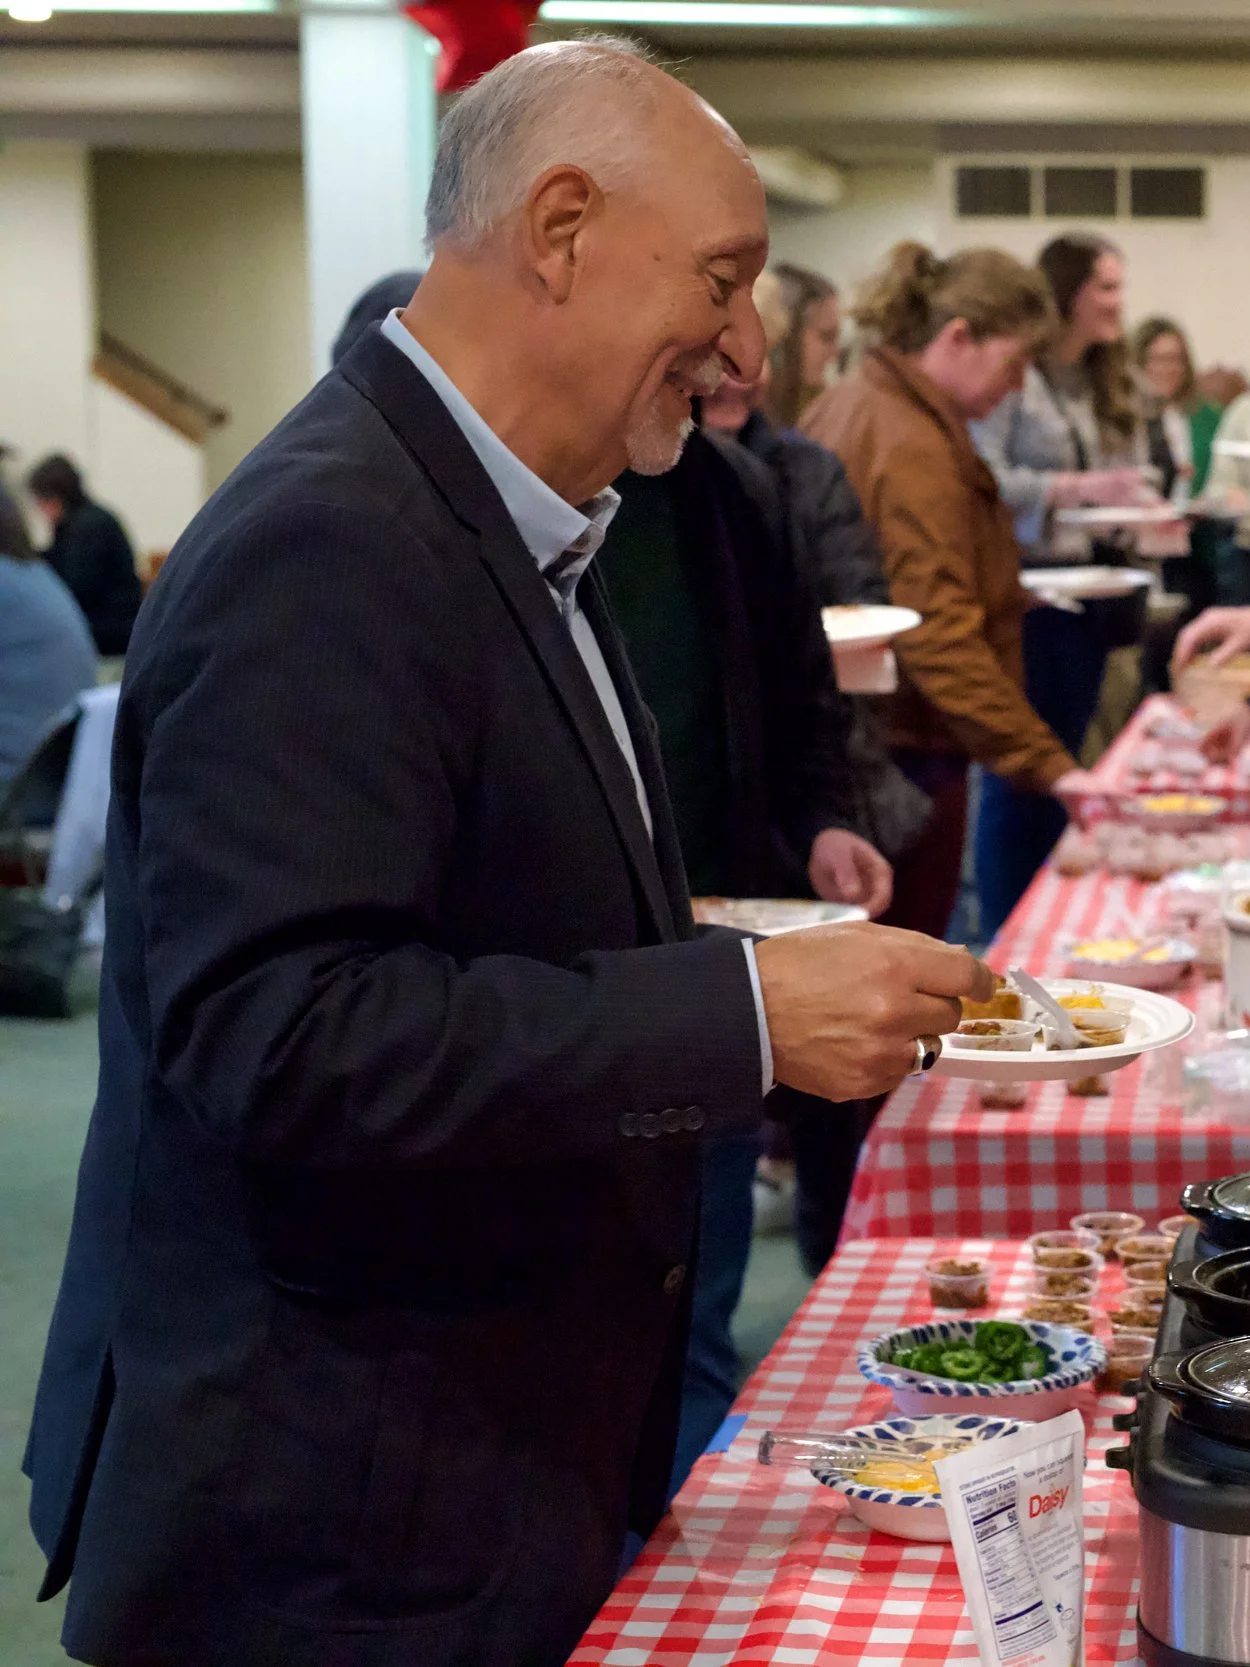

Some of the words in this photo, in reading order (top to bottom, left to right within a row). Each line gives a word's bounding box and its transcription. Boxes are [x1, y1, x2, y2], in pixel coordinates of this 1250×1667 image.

[965, 1487, 997, 1505] Nutrition
[998, 1479, 1017, 1493] Facts
[1028, 1484, 1070, 1520] Daisy
